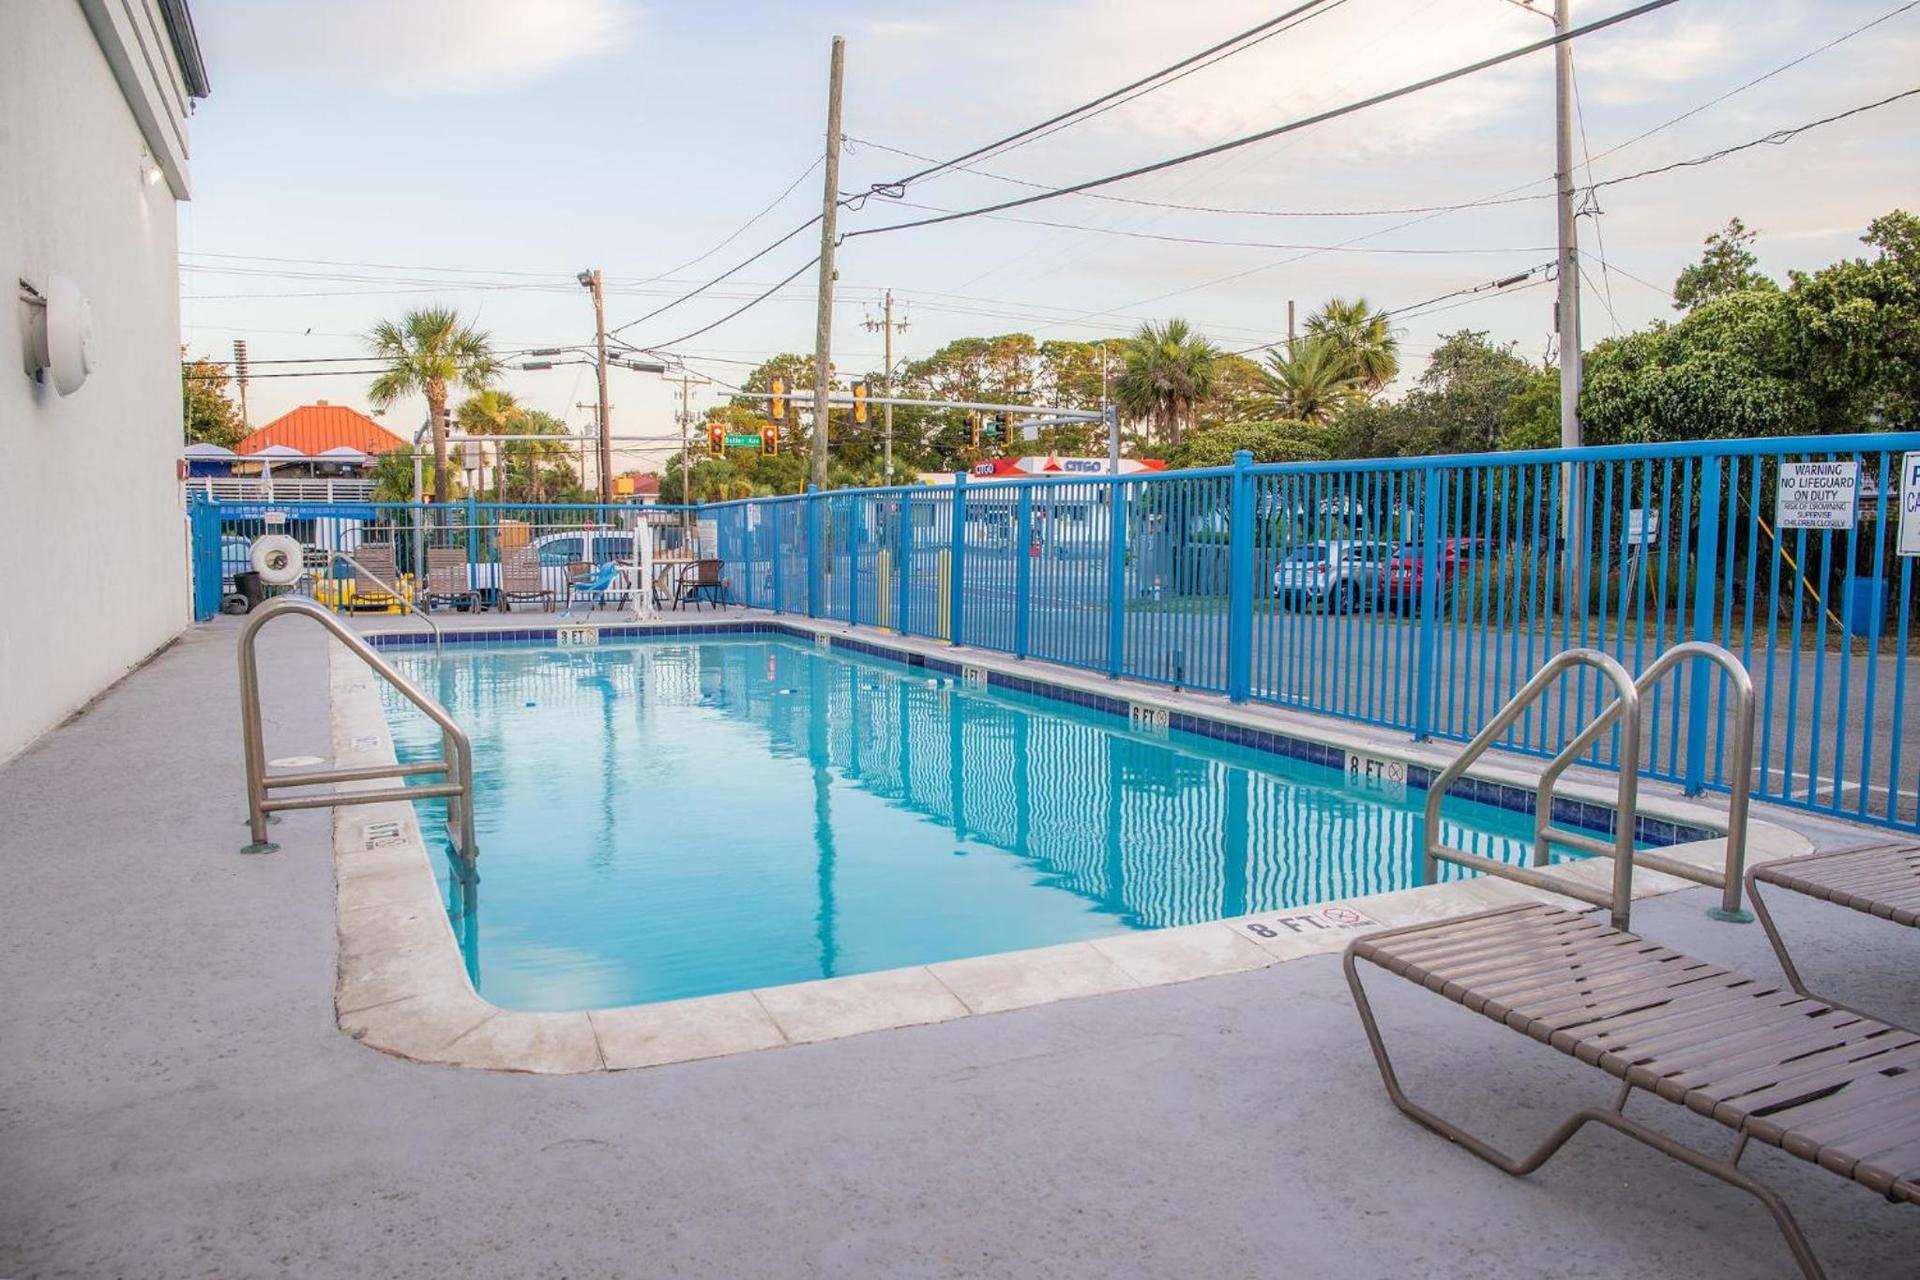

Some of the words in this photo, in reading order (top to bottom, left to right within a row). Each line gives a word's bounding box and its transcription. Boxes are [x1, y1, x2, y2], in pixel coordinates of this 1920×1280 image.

[975, 463, 994, 475] CITGO
[1064, 461, 1101, 472] CITGO
[1795, 464, 1843, 475] WARNING
[1781, 478, 1796, 488] NO
[1799, 477, 1854, 488] LIFEGUARD
[1794, 490, 1809, 501] ON
[1811, 490, 1838, 501] DUTY
[1784, 502, 1799, 510] RISK
[1799, 502, 1808, 510] OF
[1809, 502, 1847, 510] DROWNING
[1797, 511, 1832, 519] SUPERVISE
[1783, 519, 1816, 527] CHILDREN
[1816, 519, 1846, 527] CLOSELY
[1350, 756, 1359, 774] 8
[1366, 759, 1384, 779] FT
[1246, 923, 1279, 938] 8
